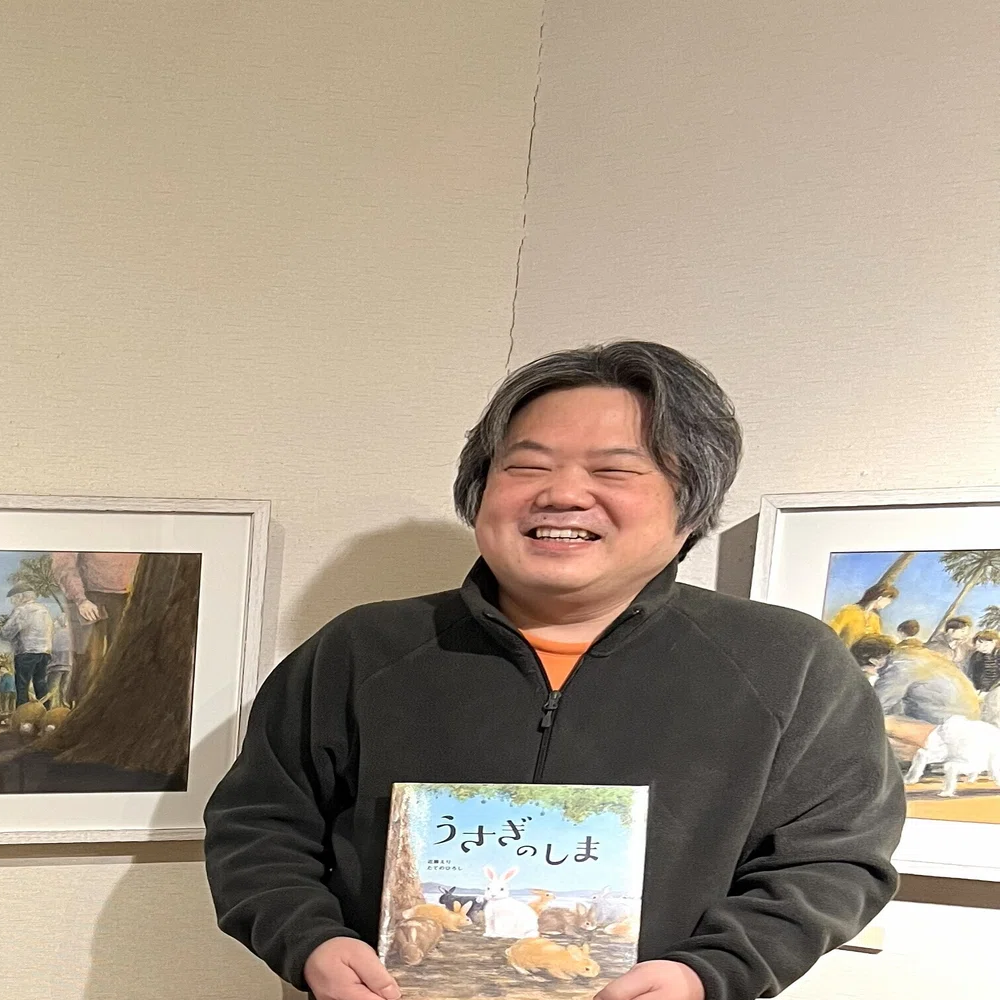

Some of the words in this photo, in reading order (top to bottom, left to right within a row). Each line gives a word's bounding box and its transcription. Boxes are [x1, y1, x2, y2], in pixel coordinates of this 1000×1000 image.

[433, 815, 600, 866] うさぎのしま
